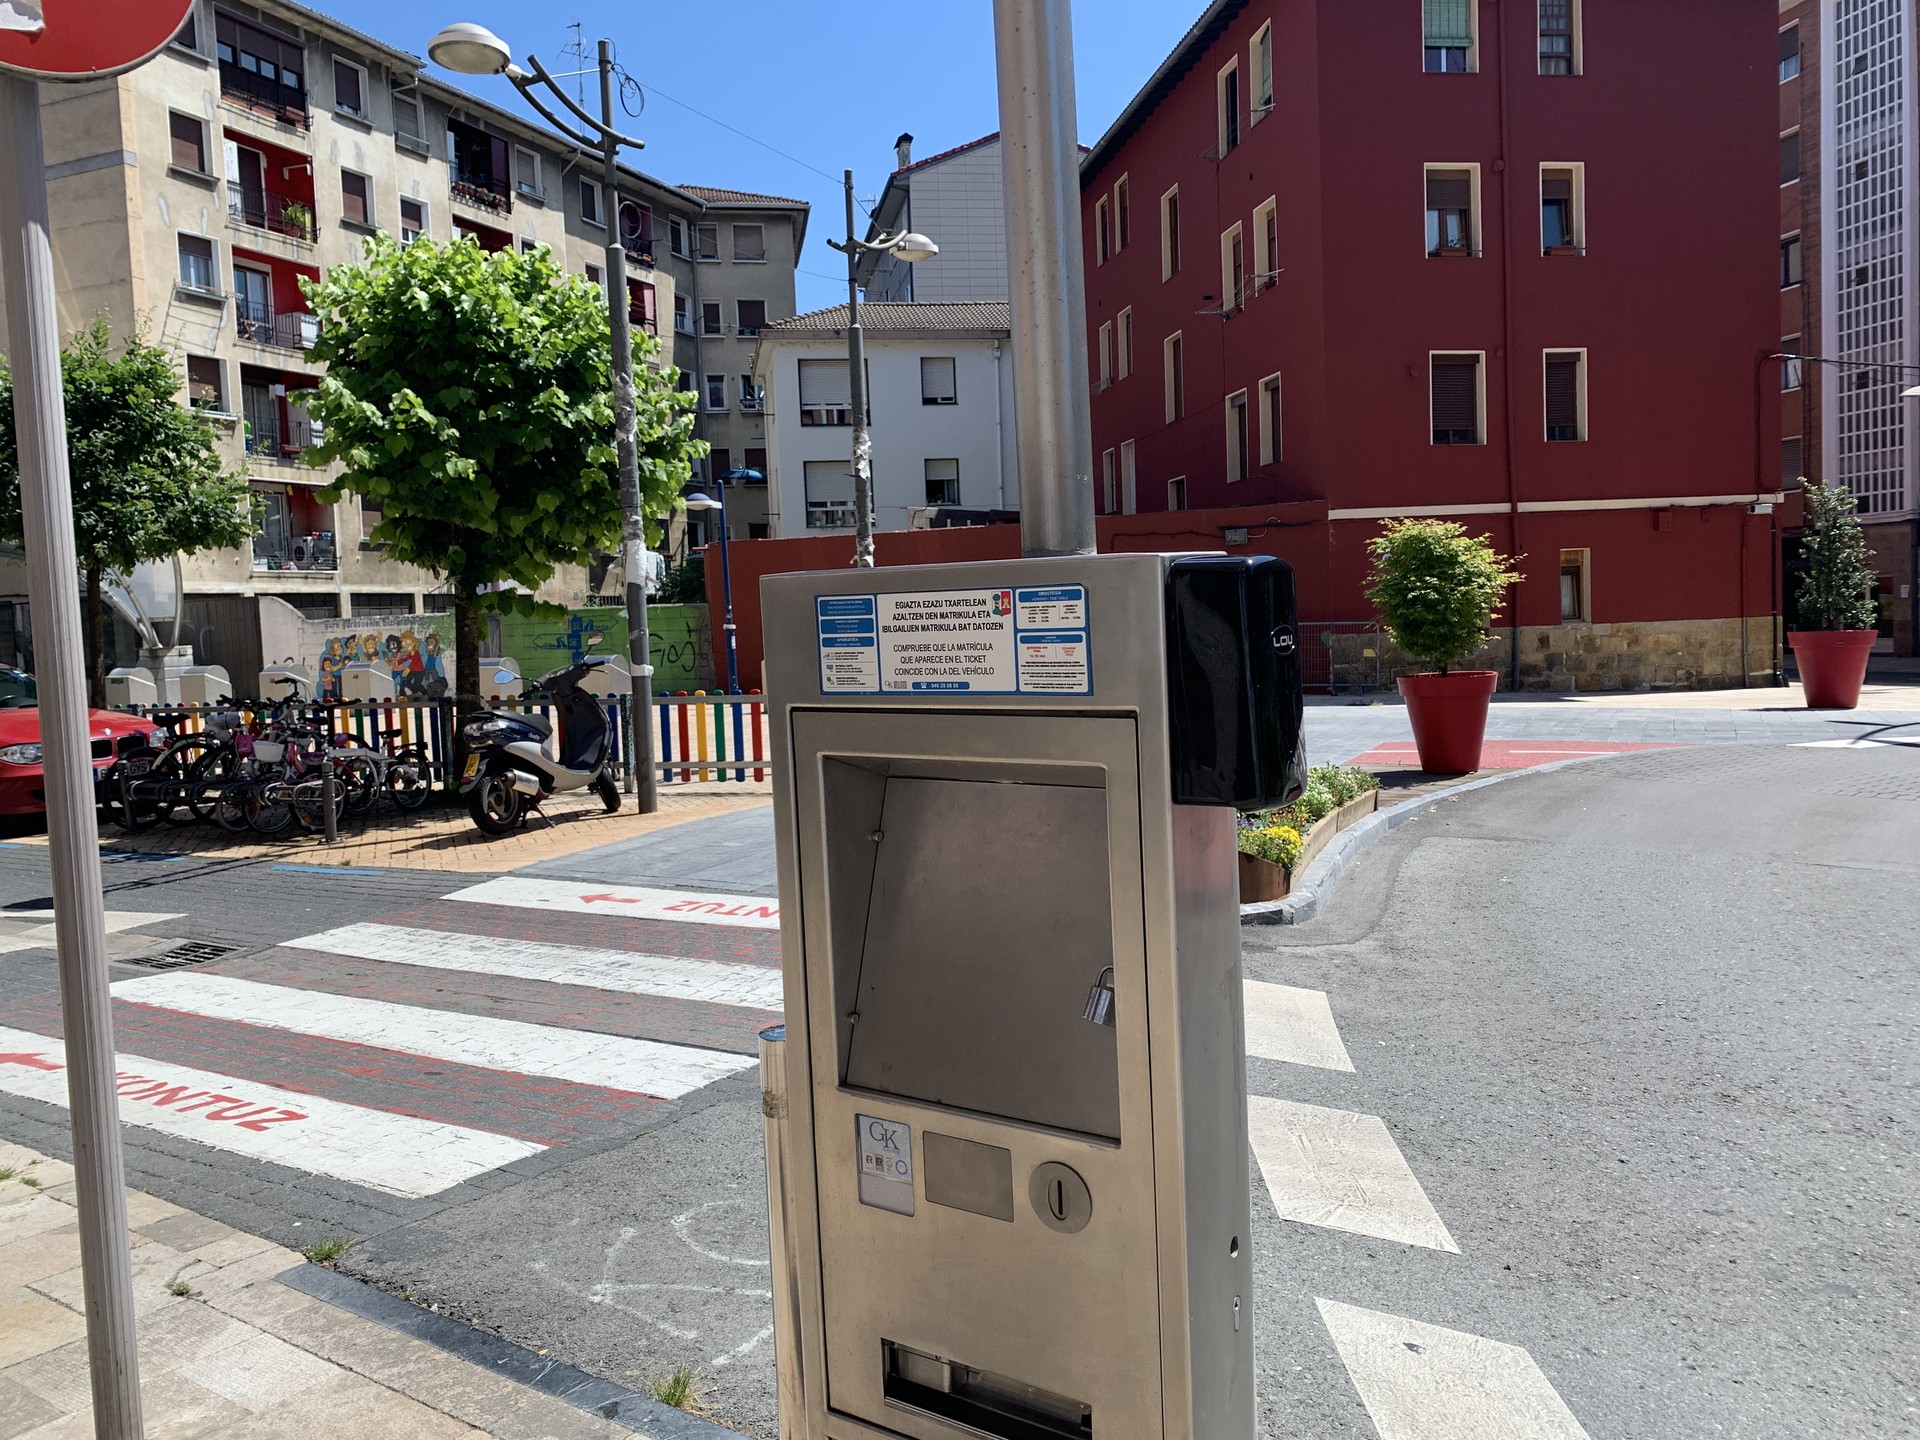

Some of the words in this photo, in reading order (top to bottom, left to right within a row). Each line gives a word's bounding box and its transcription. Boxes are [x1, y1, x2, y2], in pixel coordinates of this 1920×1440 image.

[895, 601, 921, 609] EGIAZTA
[923, 600, 943, 608] EZAZU
[944, 598, 987, 607] TXARTELEAN
[892, 613, 924, 621] AZALTZEN
[925, 612, 938, 620] DEN
[939, 611, 976, 620] MATRIKULA
[977, 610, 991, 619] ETA
[882, 625, 920, 633] IBILGAILUEN
[921, 623, 957, 632] MATRIKULA
[958, 623, 971, 631] BAT
[972, 622, 1003, 631] DATOZEN
[893, 643, 932, 652] COMPRUEBE
[932, 643, 946, 652] QUE
[947, 643, 956, 651] LA
[957, 641, 993, 651] MATRÍCULA
[900, 656, 913, 664] QUE
[914, 655, 944, 664] APARECE
[945, 655, 954, 663] EN
[954, 655, 963, 663] EL
[963, 654, 987, 663] TICKET
[894, 667, 924, 676] COINCIDE
[924, 667, 938, 676] CON
[939, 667, 948, 675] LA
[948, 667, 961, 675] DEL
[962, 665, 995, 675] VEHÍCULO
[129, 762, 147, 774] GYS
[662, 900, 779, 918] NTUZ
[869, 1121, 900, 1150] GK
